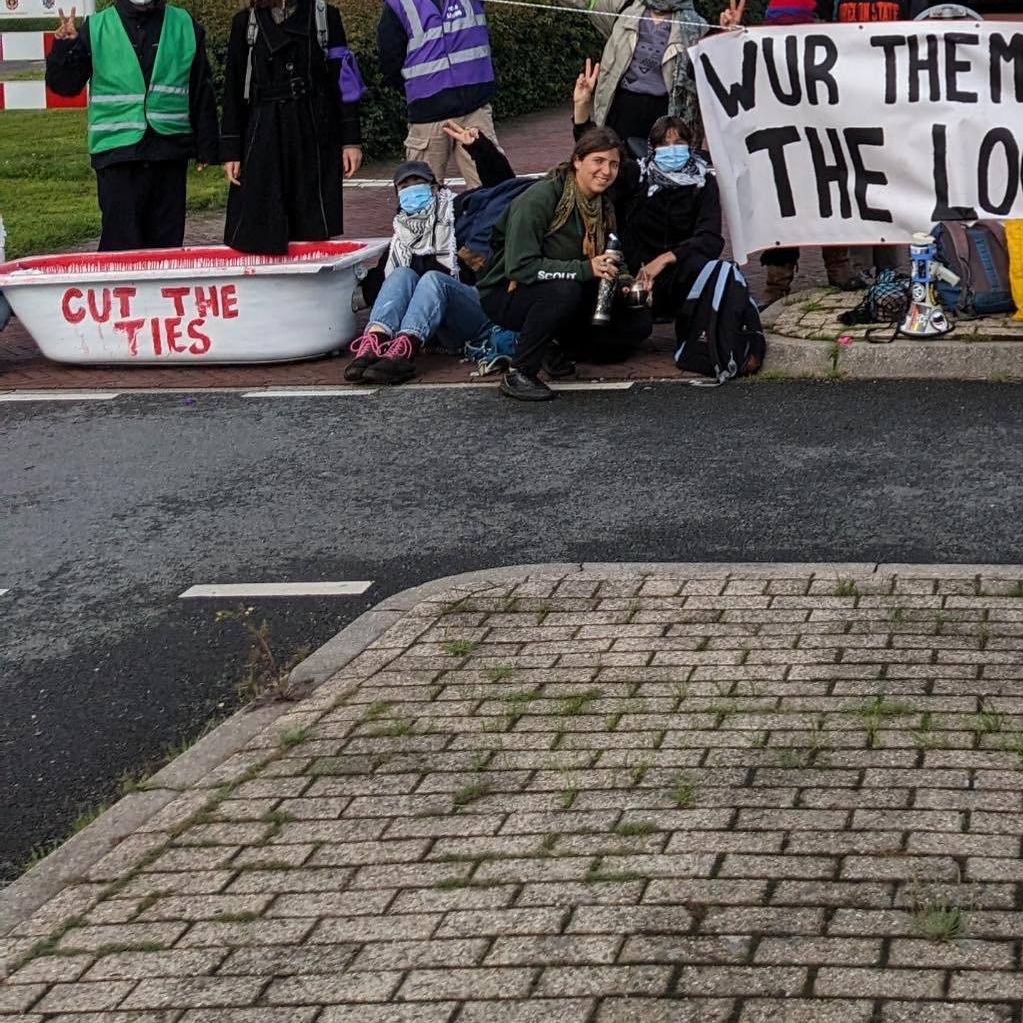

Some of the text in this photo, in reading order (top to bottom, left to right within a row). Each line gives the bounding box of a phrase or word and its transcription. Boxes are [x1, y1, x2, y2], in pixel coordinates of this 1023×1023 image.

[701, 34, 838, 118] WUR
[871, 33, 979, 104] THE
[745, 124, 893, 223] THE
[62, 284, 239, 324] CUT THE
[114, 317, 212, 357] TIES
